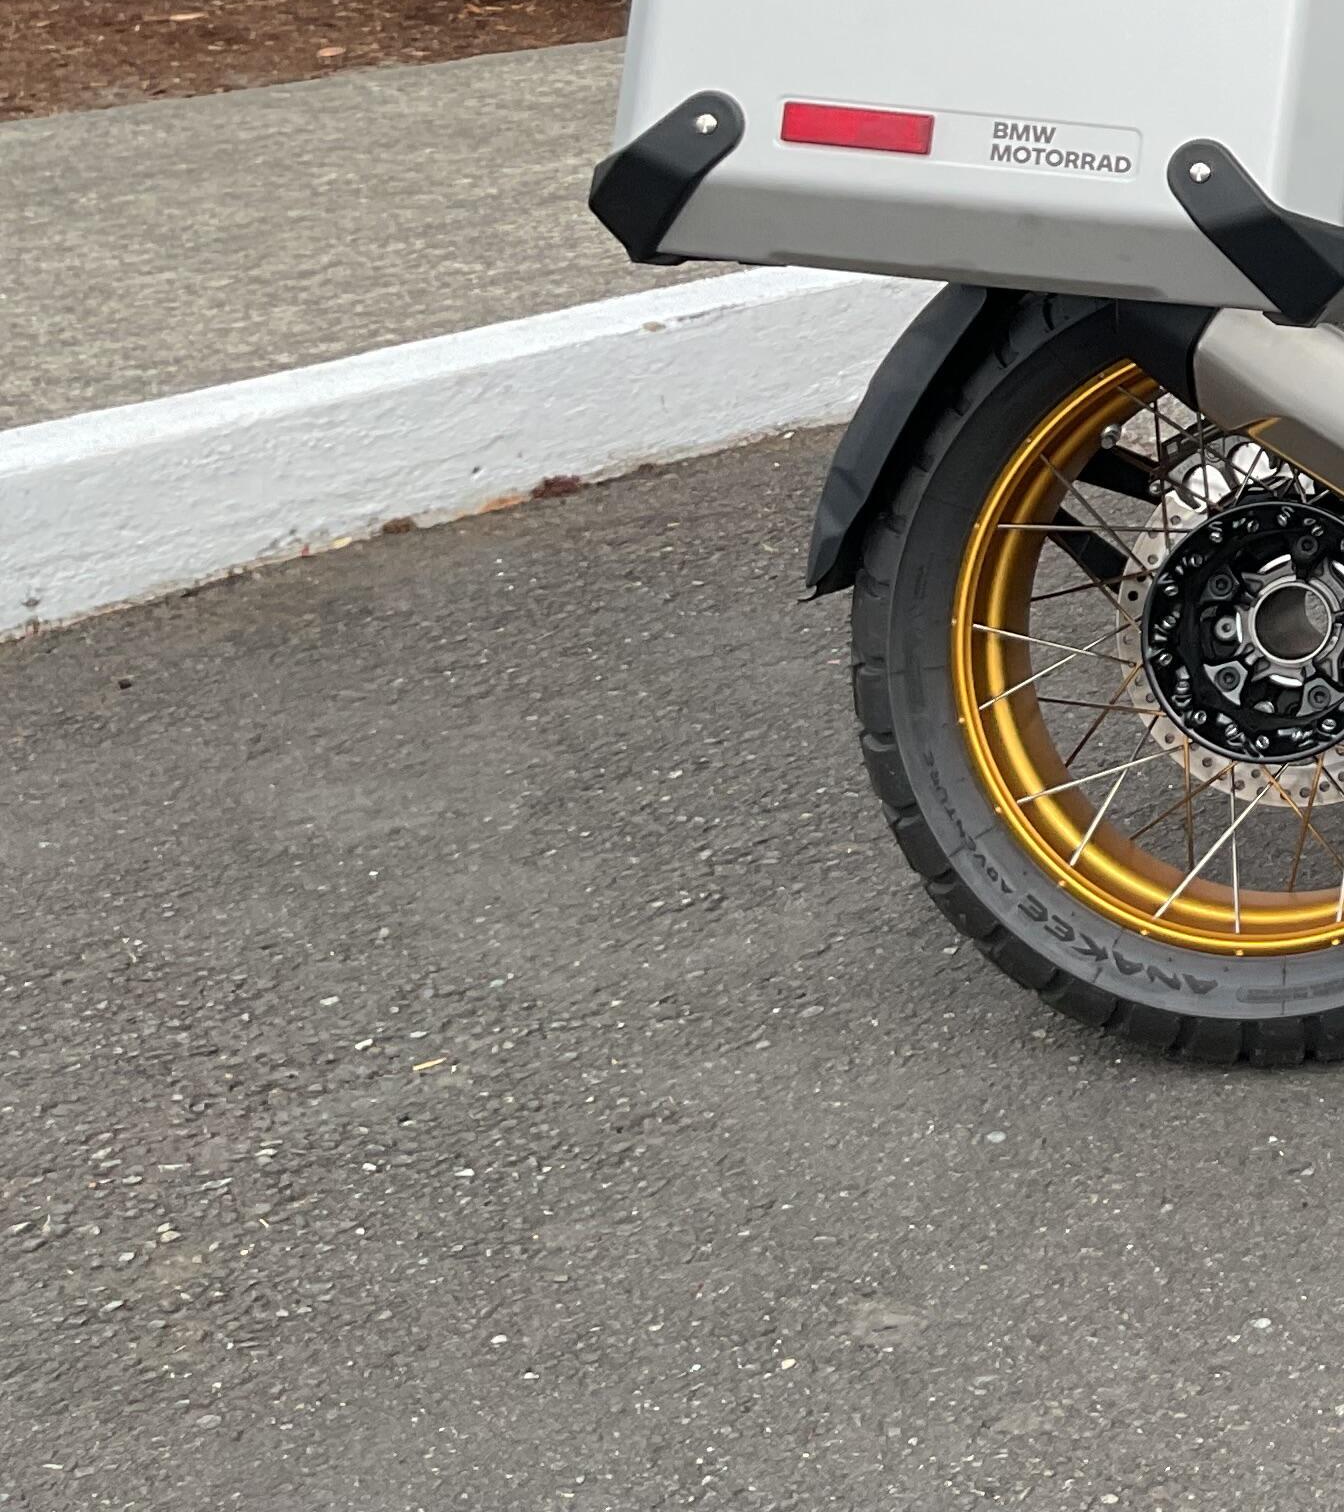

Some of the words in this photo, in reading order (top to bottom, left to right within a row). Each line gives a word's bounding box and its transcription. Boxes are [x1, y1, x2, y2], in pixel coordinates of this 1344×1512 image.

[992, 120, 1057, 145] BMW
[989, 143, 1132, 174] MOTORRAD
[1017, 893, 1220, 996] ANAKEE
